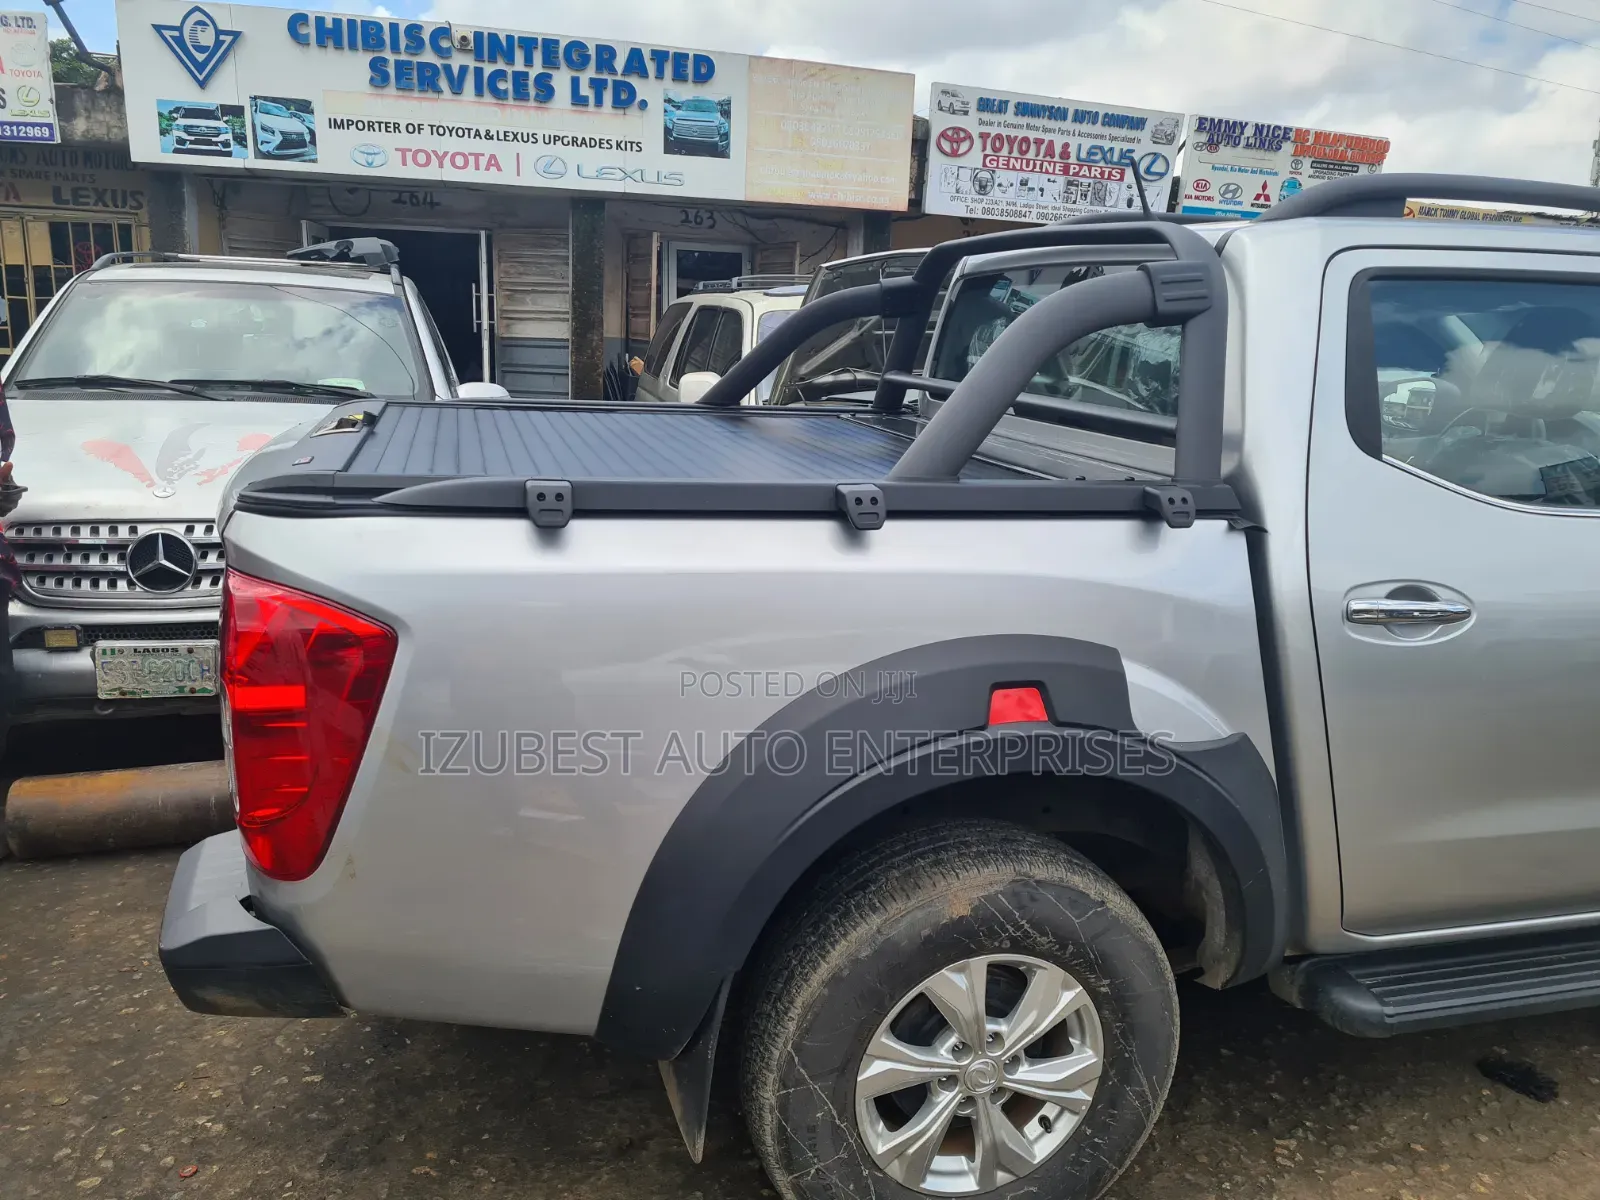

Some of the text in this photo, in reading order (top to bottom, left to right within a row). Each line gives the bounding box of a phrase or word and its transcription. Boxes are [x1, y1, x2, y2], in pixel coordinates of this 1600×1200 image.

[14, 15, 36, 29] LTD.
[287, 12, 716, 83] CHIBISC INTEGRATED
[9, 69, 43, 79] TOYOTA
[368, 55, 649, 110] SERVICES LTD.
[976, 96, 1011, 115] GREAT
[1072, 109, 1099, 126] AUTO
[1101, 112, 1148, 131] COMPANY
[328, 117, 401, 134] IMPORTER
[405, 121, 425, 135] OF
[542, 134, 613, 151] UPGRADES
[615, 139, 643, 153] KITS
[978, 117, 996, 128] Dealer
[1003, 120, 1025, 132] Genuine
[1025, 123, 1041, 133] Motor
[1041, 125, 1057, 136] Spare
[1057, 127, 1071, 137] Parts
[1077, 130, 1108, 142] Accessories
[1195, 117, 1293, 141] EMMY NICE
[1207, 131, 1283, 152] AUTO LINKS
[979, 131, 1135, 167] TOYOTA & LEXUS
[10, 168, 97, 184] SPARE PARTS
[395, 147, 685, 187] TOYOTA LEXUS
[985, 155, 1122, 181] GENUINE PARTS
[52, 185, 145, 210] LEXUS
[965, 205, 979, 215] Tel:
[679, 209, 717, 229] 263
